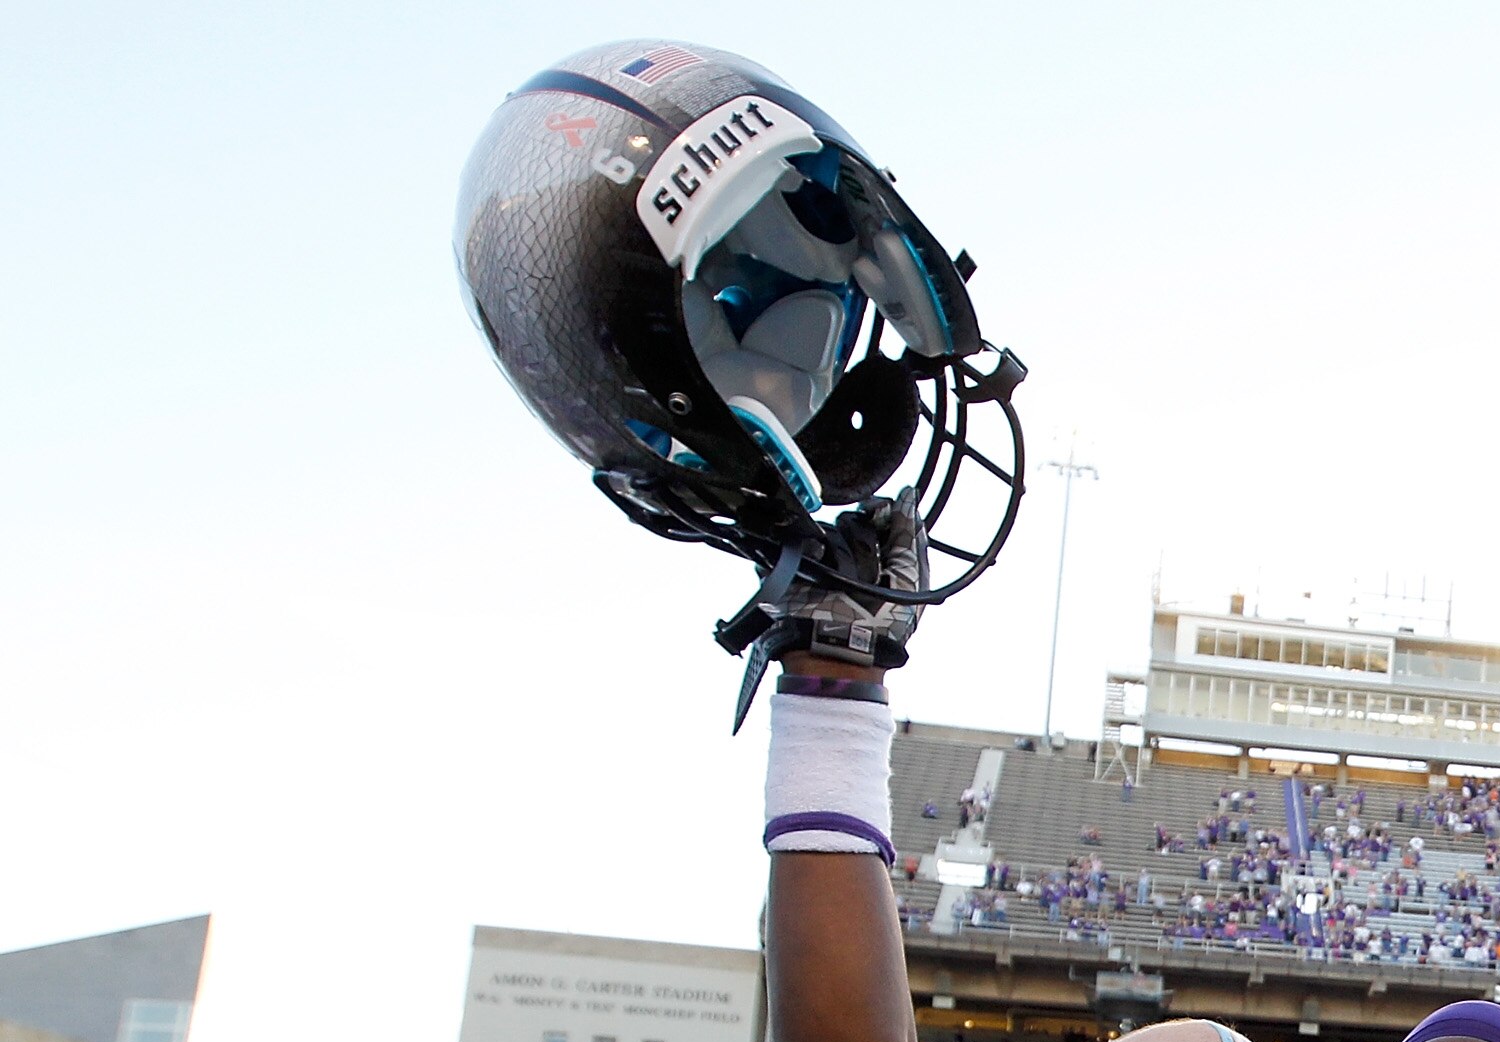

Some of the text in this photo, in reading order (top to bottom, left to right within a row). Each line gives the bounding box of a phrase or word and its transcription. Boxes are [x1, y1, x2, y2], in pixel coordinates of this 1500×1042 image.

[590, 147, 637, 185] 6
[652, 101, 774, 225] schutt
[490, 973, 544, 987] AMON
[574, 977, 646, 995] CARTER
[652, 984, 732, 1004] STADIUM
